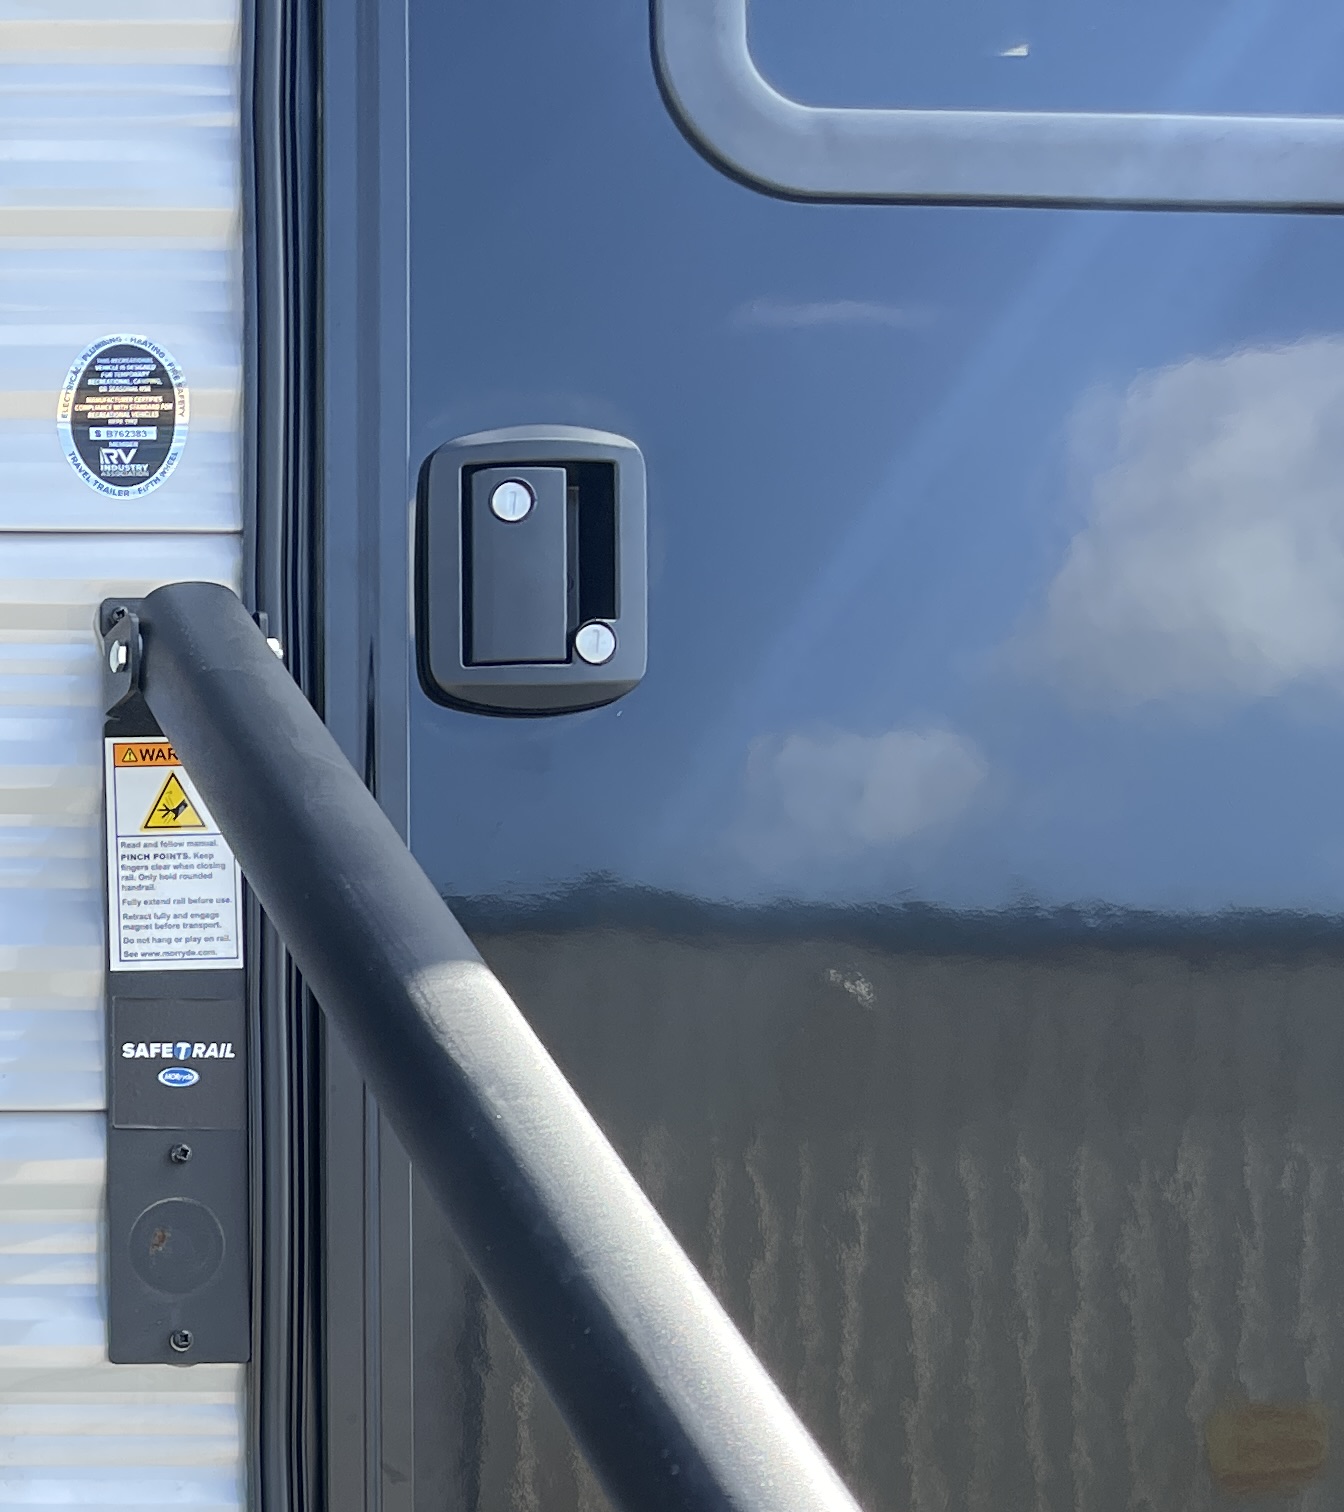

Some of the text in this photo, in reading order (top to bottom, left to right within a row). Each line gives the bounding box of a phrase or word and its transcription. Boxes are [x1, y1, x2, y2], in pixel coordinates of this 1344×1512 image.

[61, 336, 186, 419] ELECTRICAL PLUMBING HEATING FIRE SAFETY
[99, 447, 138, 464] RV
[100, 464, 149, 472] INDUSTRY
[68, 451, 179, 496] TRAVEL TRAILER FIFTH WHEEL
[120, 841, 141, 849] Read
[143, 841, 159, 849] and
[160, 840, 185, 848] follow
[121, 852, 214, 861] PINCH POINTS. Keep
[121, 863, 149, 873] fingers
[172, 862, 195, 871] when
[196, 862, 226, 871] closing
[138, 873, 157, 882] Only
[159, 873, 177, 881] hold
[179, 872, 213, 880] rounded
[122, 898, 142, 907] Fully
[173, 897, 186, 905] rail
[153, 912, 171, 922] fully
[190, 912, 220, 921] engage
[122, 921, 222, 932] magnet before transport.
[152, 937, 172, 945] hang
[184, 936, 202, 945] play
